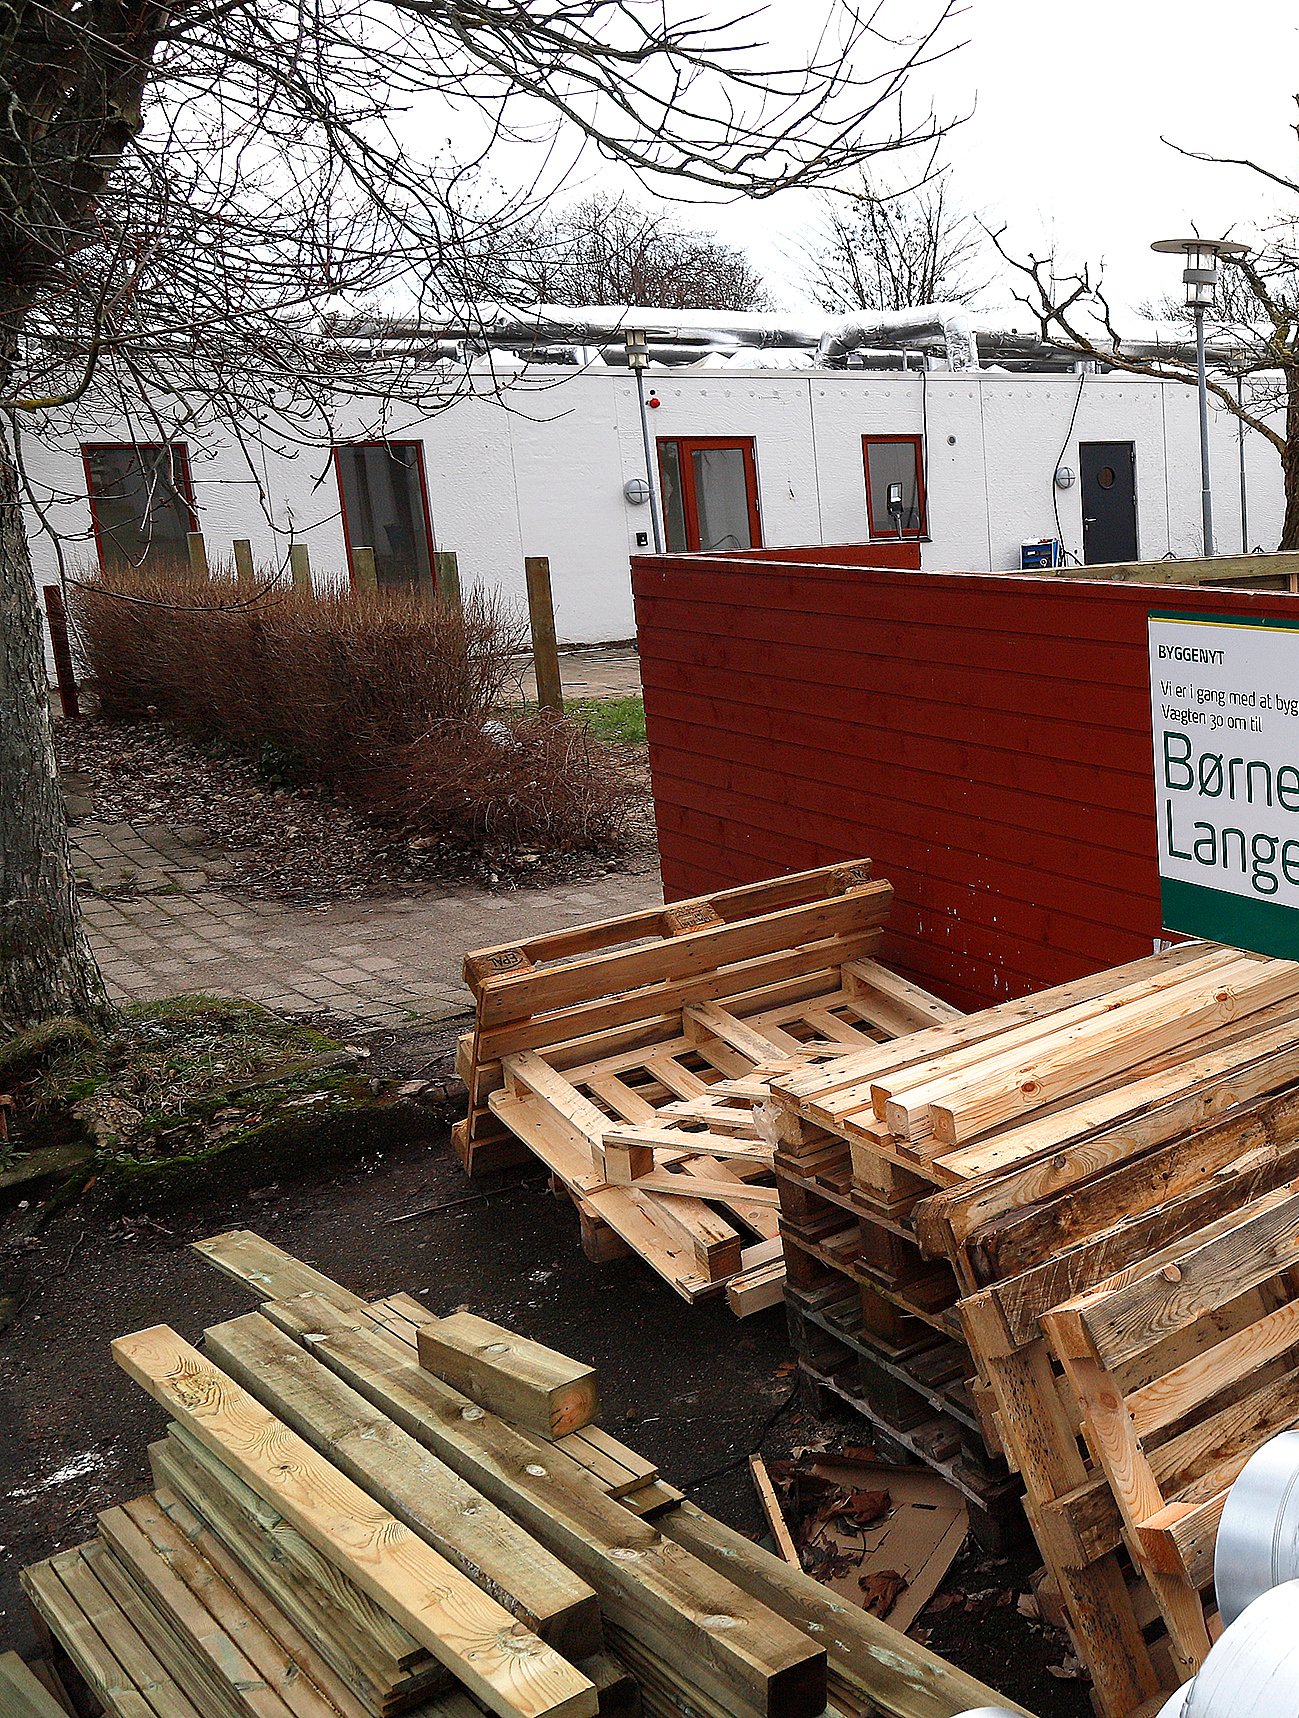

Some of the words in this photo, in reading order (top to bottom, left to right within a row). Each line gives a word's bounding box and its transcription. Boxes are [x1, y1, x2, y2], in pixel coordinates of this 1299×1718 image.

[1158, 644, 1225, 665] BYGGENYT
[1159, 680, 1173, 696] Vi
[1175, 685, 1186, 698] er
[1189, 683, 1194, 699] i
[1197, 687, 1226, 707] gang
[1229, 691, 1256, 707] med
[1259, 695, 1272, 710] at
[1161, 704, 1206, 726] Vægten
[1209, 716, 1224, 731] 30
[1227, 717, 1247, 730] om
[1250, 715, 1262, 732] til
